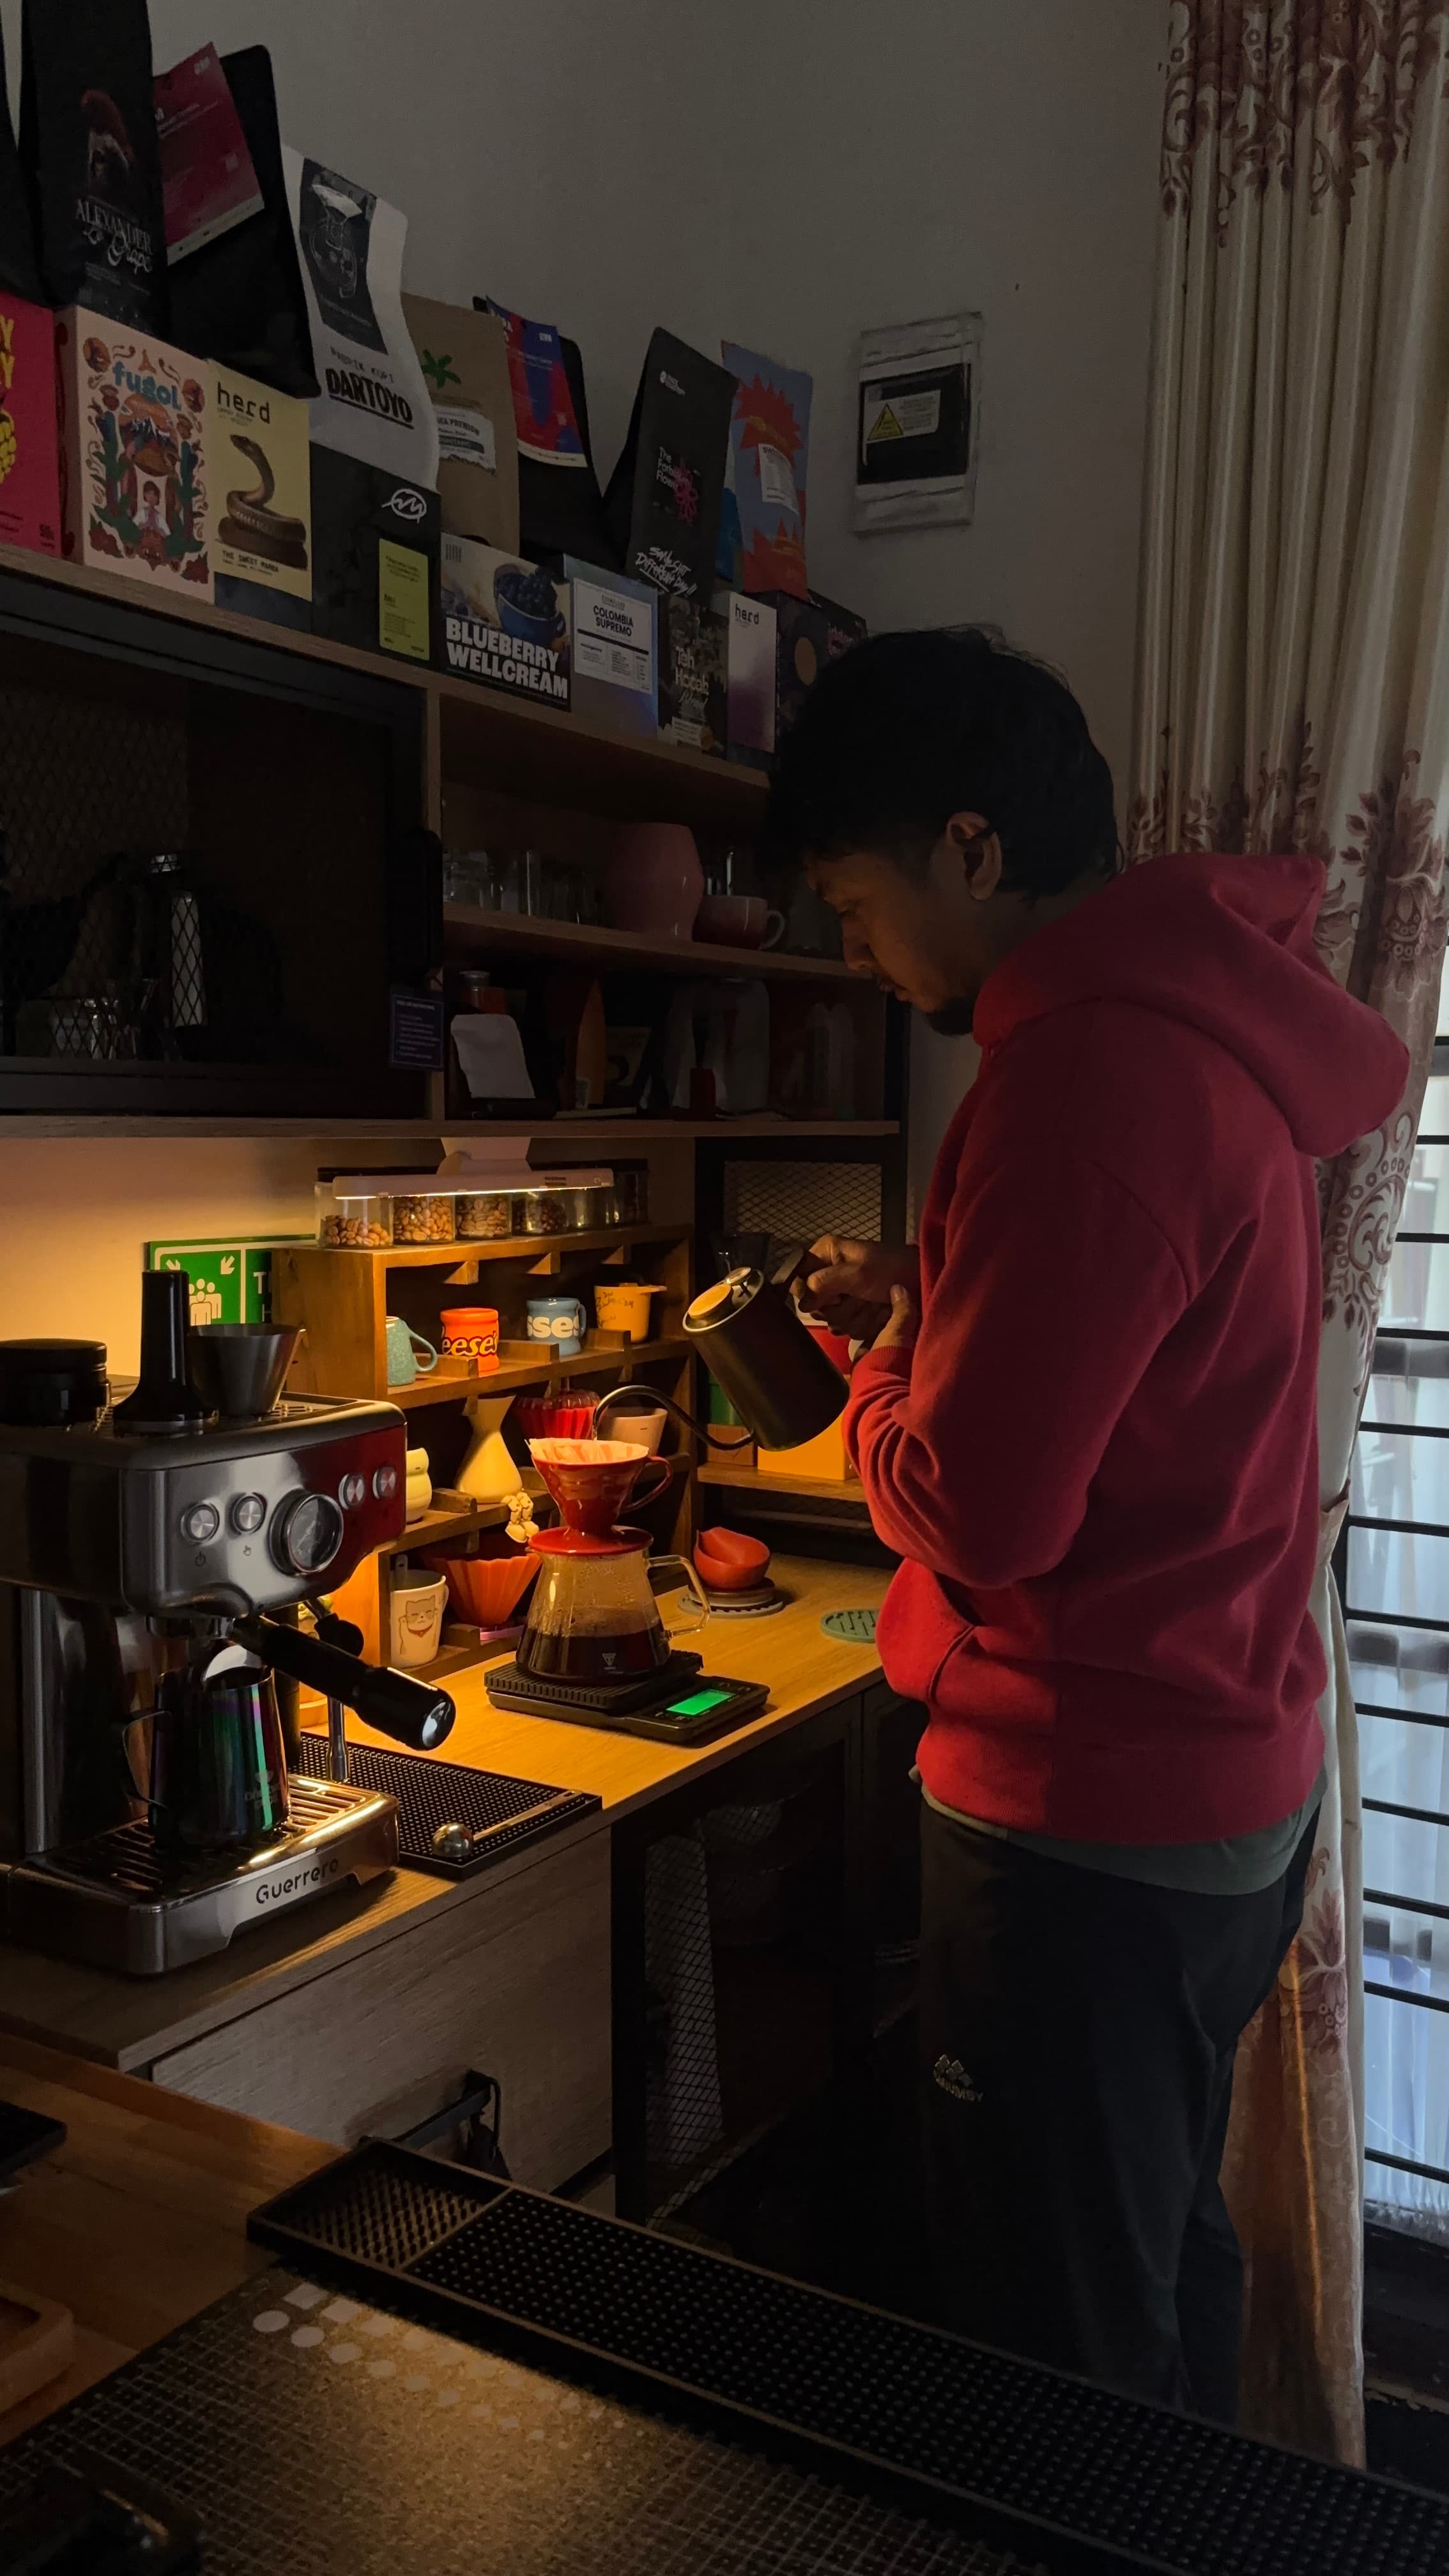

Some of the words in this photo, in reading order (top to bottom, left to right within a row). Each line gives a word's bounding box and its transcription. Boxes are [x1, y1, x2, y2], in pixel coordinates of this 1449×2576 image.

[76, 199, 154, 256] ALEXANDER
[217, 381, 270, 425] herd
[325, 368, 413, 424] DARTOYO
[593, 605, 634, 627] COLOMBIA
[595, 617, 632, 637] SUPREMO
[735, 603, 760, 625] herd
[446, 617, 560, 673] BLUEBERRY
[447, 641, 568, 700] WELLCREAM
[441, 1329, 498, 1356] eese's
[256, 1857, 339, 1905] Guerrero
